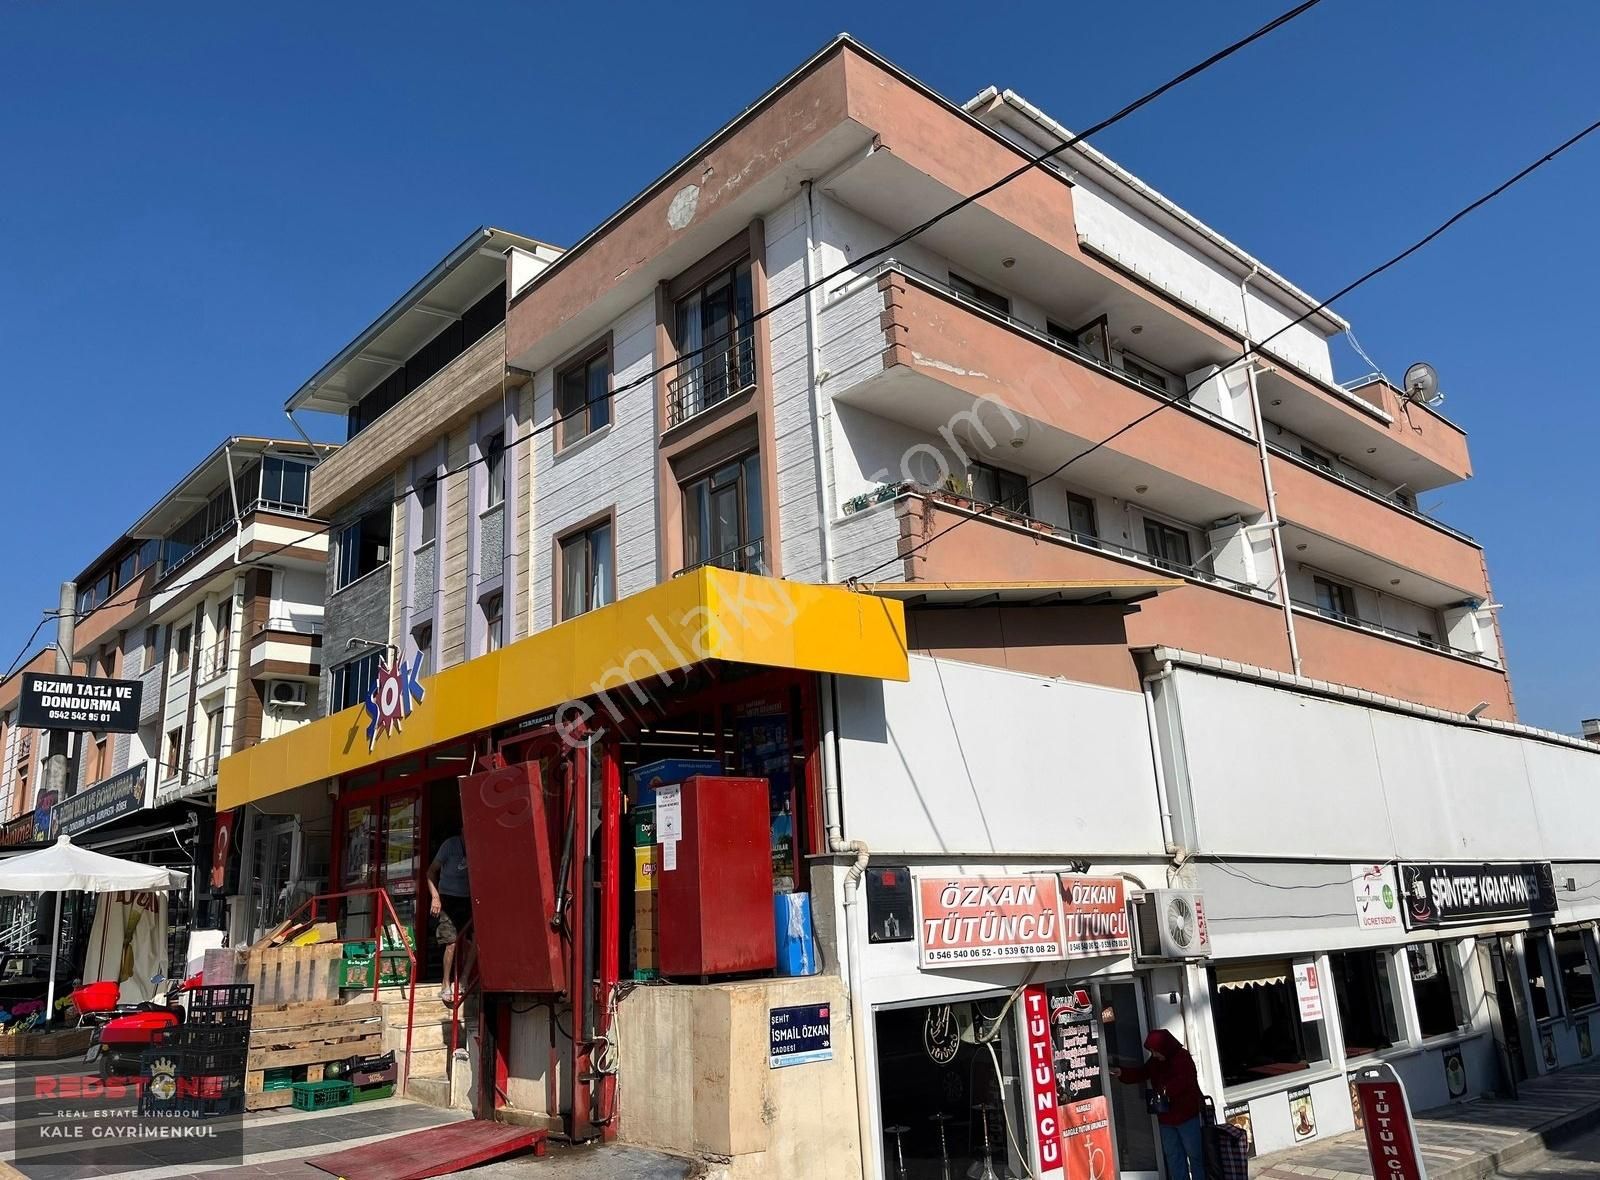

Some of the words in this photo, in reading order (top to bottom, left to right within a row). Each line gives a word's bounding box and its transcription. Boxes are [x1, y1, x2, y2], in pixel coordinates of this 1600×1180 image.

[115, 686, 132, 699] VE
[41, 695, 121, 712] DONDURMA
[49, 710, 70, 720] 0542
[71, 712, 86, 721] 542
[100, 713, 111, 722] 01
[940, 882, 1036, 909] ÖZKAN
[1072, 881, 1116, 904] ÖZKAN
[924, 908, 1055, 945] TÜTÜNCÜ
[1066, 907, 1128, 938] TÜTÜNCÜ
[929, 952, 934, 960] 0
[936, 950, 952, 959] 546
[953, 949, 968, 959] 540
[970, 949, 980, 958] 06
[981, 948, 992, 957] 52
[998, 947, 1003, 955] 0
[1005, 946, 1018, 955] 539
[1020, 945, 1034, 954] 678
[1035, 945, 1045, 953] 08
[1047, 944, 1056, 953] 29
[771, 1013, 789, 1025] ŞEHİT
[772, 1026, 801, 1042] İSMAİL
[802, 1024, 829, 1038] ÖZKAN
[772, 1043, 796, 1054] CADDESİ
[1028, 994, 1058, 1163] TÜTÜNCÜ
